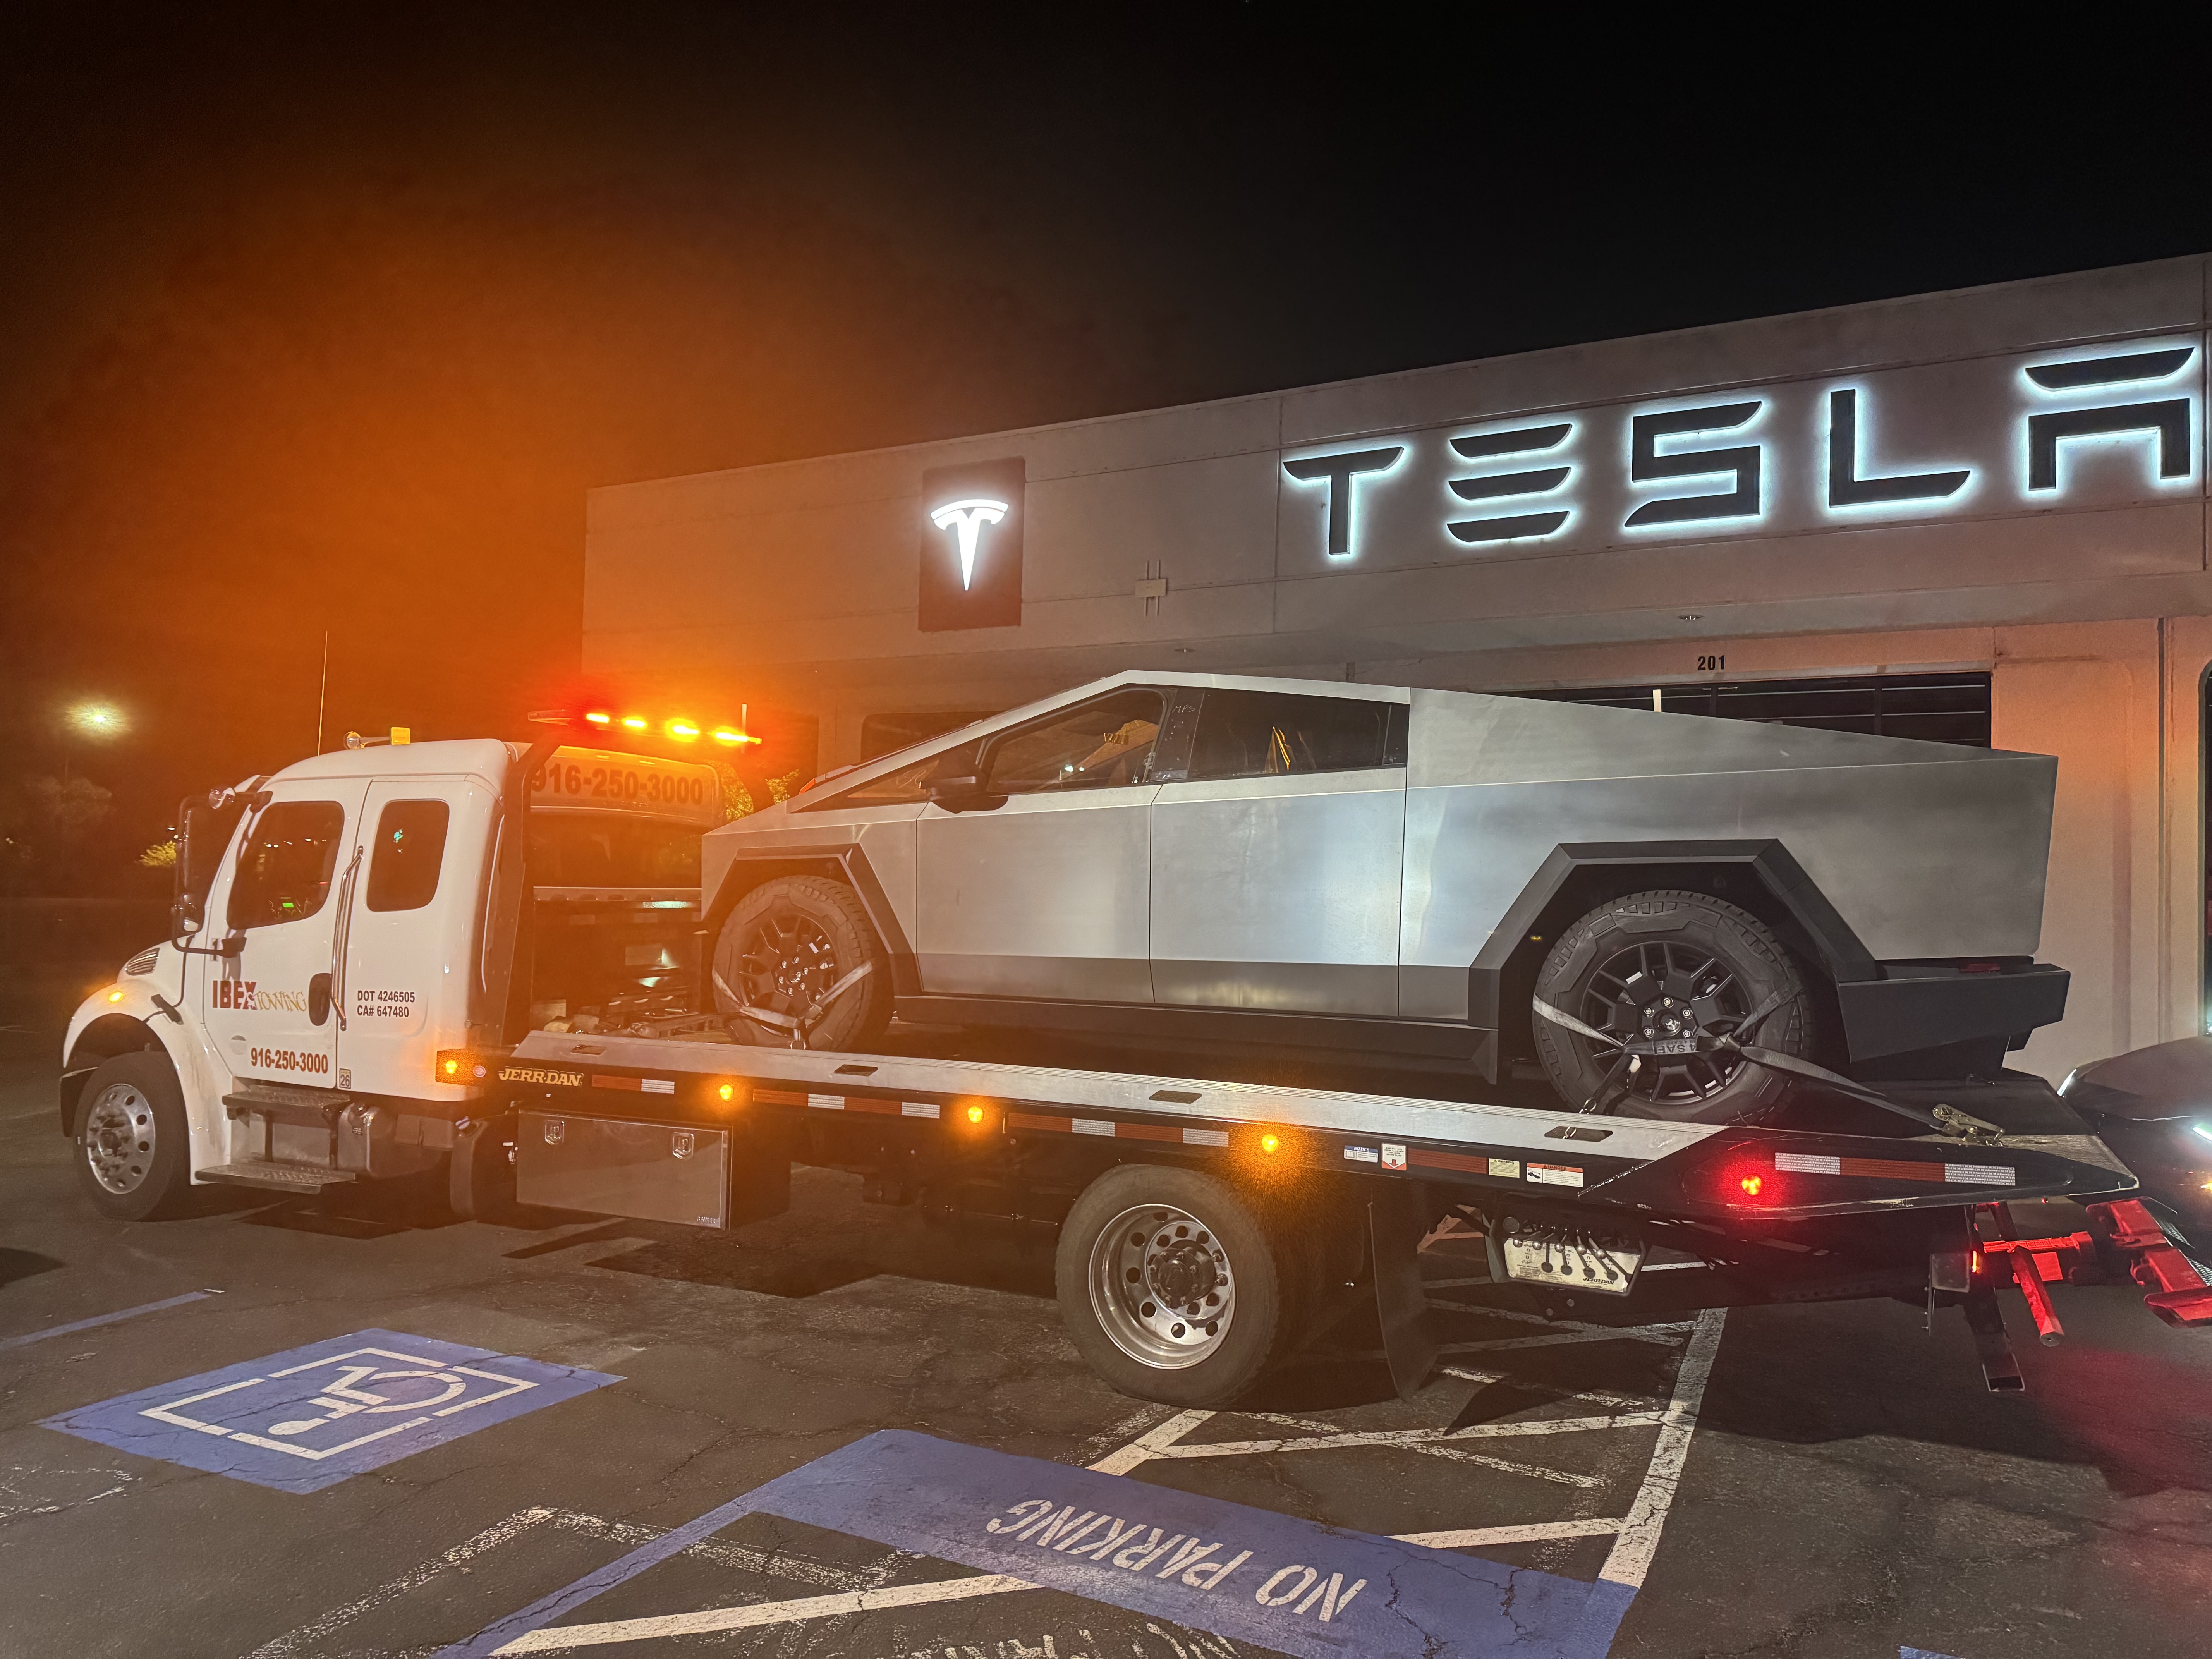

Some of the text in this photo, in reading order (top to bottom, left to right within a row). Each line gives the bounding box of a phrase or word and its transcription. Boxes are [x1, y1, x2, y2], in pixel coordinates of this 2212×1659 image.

[1282, 347, 2195, 557] TESLA
[1697, 655, 1726, 671] 201
[531, 763, 704, 805] 916-250-3000
[212, 980, 307, 1012] IBEX TOWING
[357, 990, 415, 1003] DOT 4246505
[357, 1005, 409, 1017] CA# 647480
[251, 1047, 329, 1074] 916-250-3000
[340, 1074, 350, 1087] 26
[986, 1499, 1368, 1622] NO PARKING
